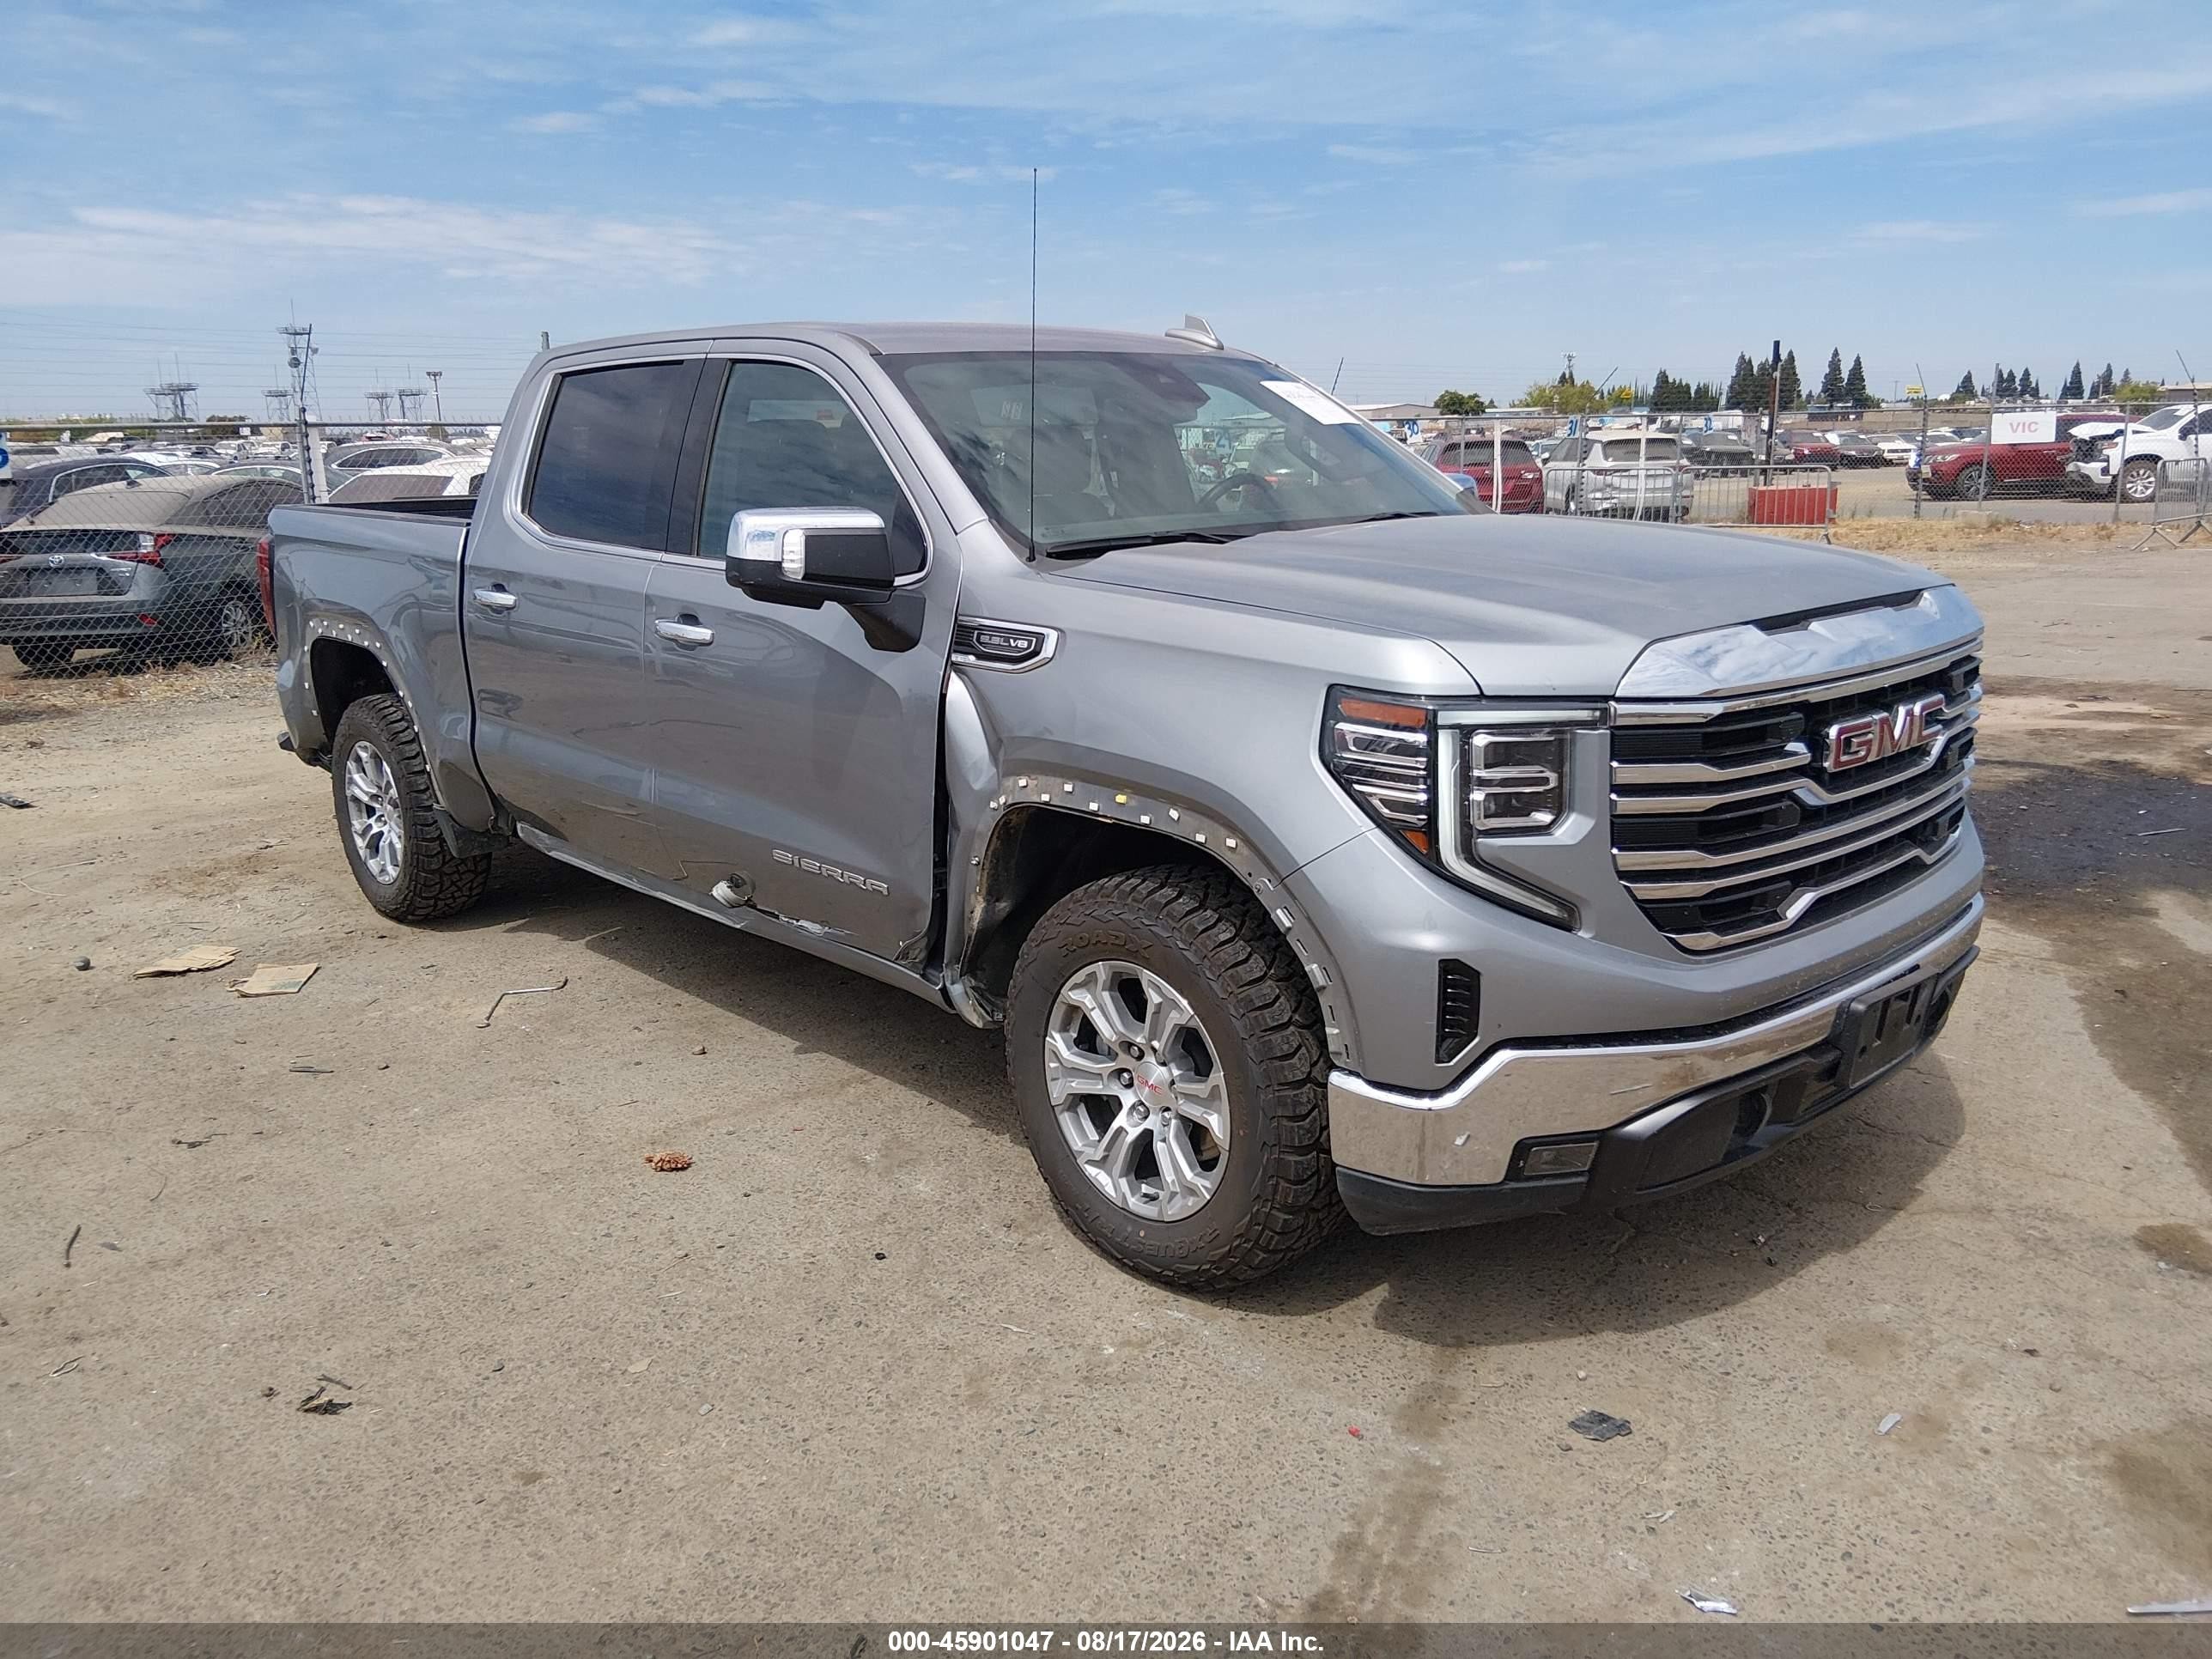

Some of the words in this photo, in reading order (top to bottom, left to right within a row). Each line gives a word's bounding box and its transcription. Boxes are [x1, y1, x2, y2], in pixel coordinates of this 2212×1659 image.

[1404, 421, 1419, 438] 30
[1567, 419, 1578, 437] 31
[1704, 417, 1713, 434] 32
[2009, 421, 2039, 434] VIC
[1823, 693, 1946, 773] GMC
[772, 849, 889, 896] SIERRA
[1137, 1073, 1164, 1096] GMC
